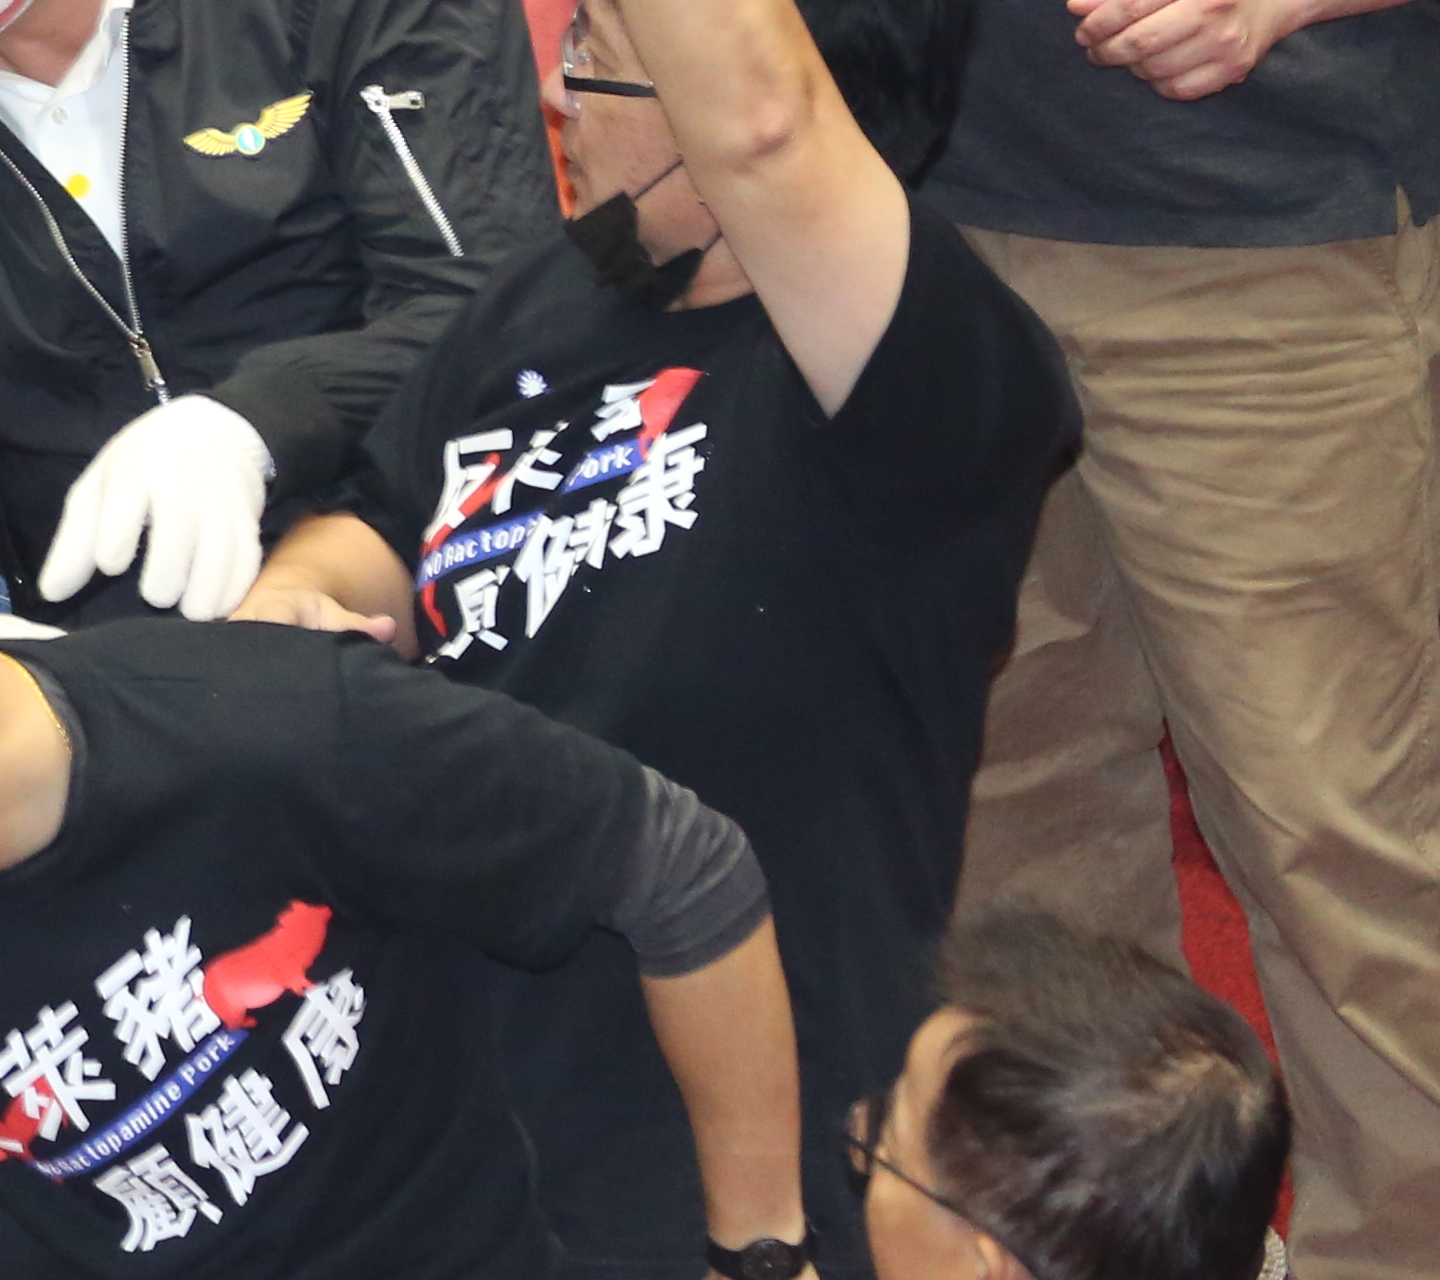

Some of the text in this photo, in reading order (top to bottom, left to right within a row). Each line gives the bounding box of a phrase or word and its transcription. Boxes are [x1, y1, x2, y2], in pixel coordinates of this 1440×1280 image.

[94, 969, 366, 1253] 顧健康
[179, 1032, 237, 1087] Pork
